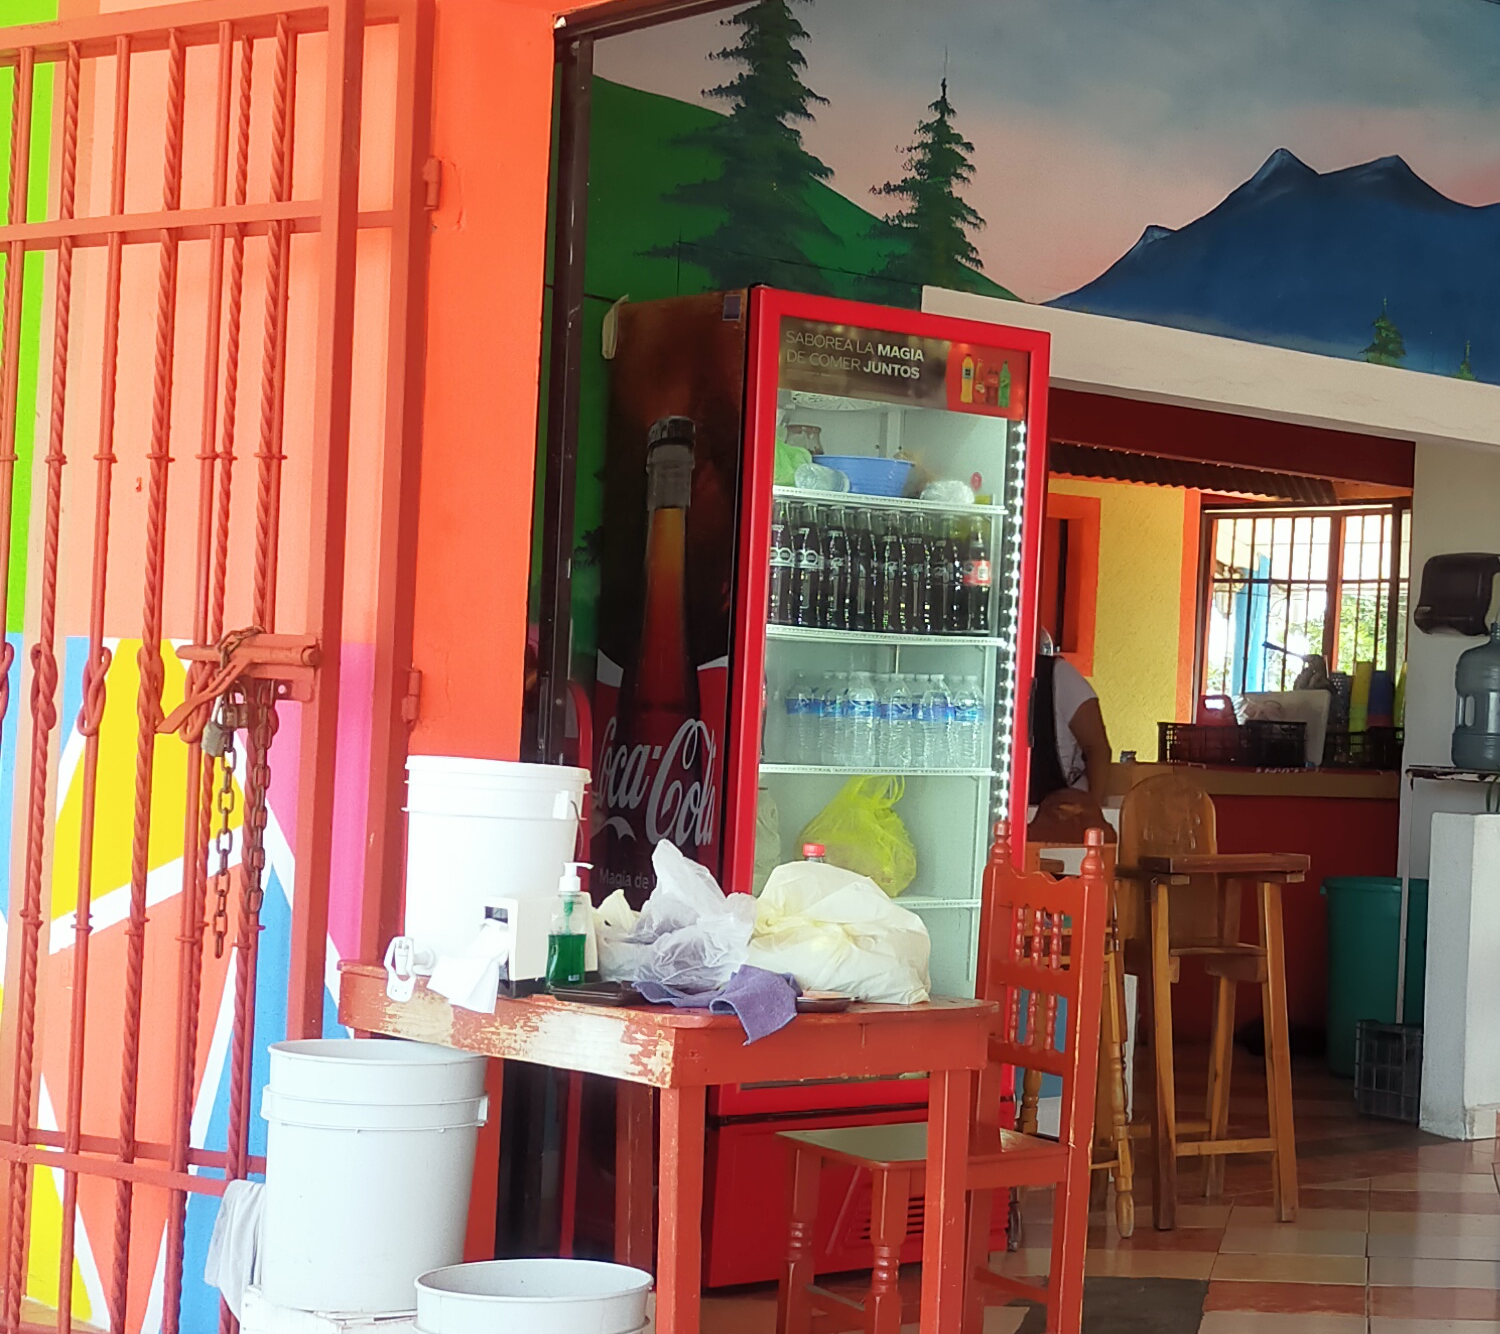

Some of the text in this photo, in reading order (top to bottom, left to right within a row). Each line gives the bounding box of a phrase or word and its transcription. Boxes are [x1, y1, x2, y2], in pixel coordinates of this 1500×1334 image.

[785, 330, 925, 362] SABOREA LA MAGIA
[786, 349, 806, 364] DE
[809, 352, 861, 371] COMER
[863, 360, 921, 380] JUNTOS
[597, 716, 717, 848] Coca-Cola
[599, 867, 632, 888] Magia
[634, 871, 649, 889] de
